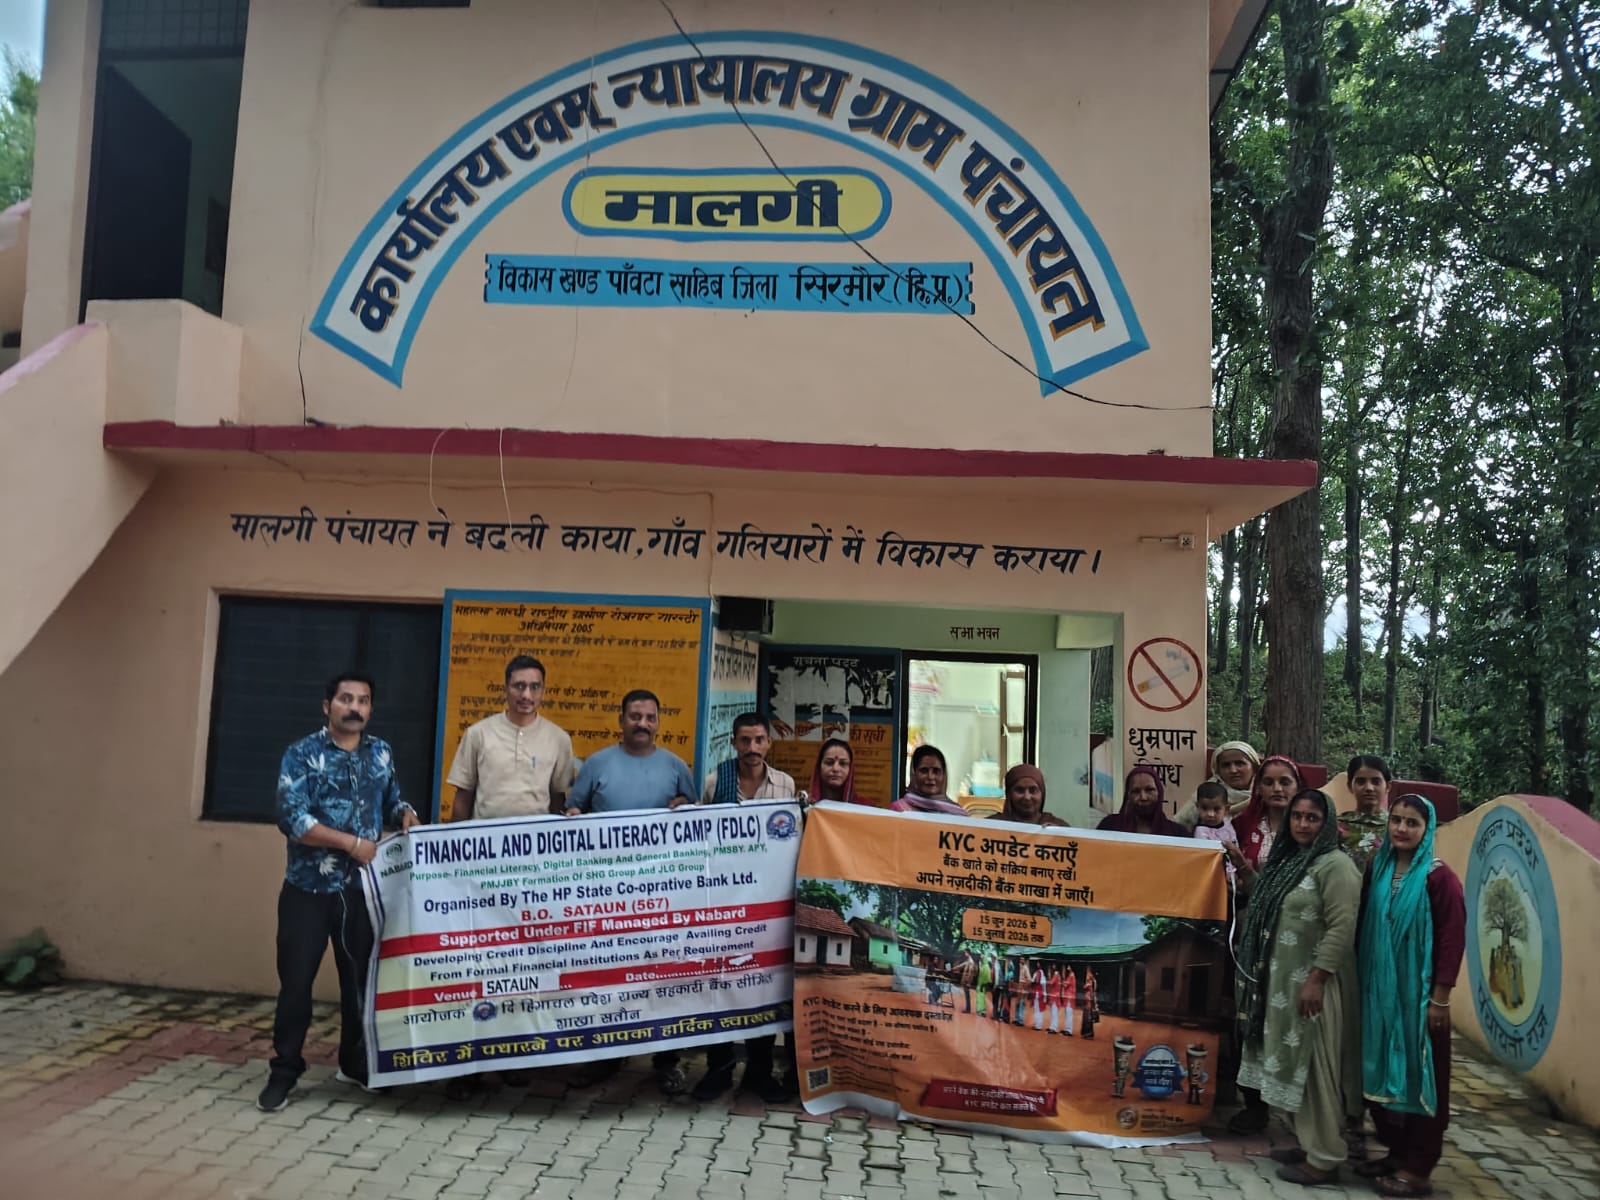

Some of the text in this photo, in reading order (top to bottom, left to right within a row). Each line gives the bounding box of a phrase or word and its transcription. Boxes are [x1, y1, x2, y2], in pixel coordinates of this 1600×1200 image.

[496, 82, 617, 161] एवम्
[608, 55, 850, 119] न्यायालय
[848, 78, 967, 172] ग्राम
[959, 141, 1106, 341] पंचायत
[605, 179, 843, 227] मालगी
[498, 261, 557, 292] विकास
[559, 268, 599, 294] खण्ड
[607, 263, 662, 296] पाँवटा
[669, 266, 723, 304] साहिब
[731, 266, 777, 301] जिला
[793, 266, 889, 307] सिरमौर
[230, 506, 318, 546] मालगी
[325, 509, 419, 548] पंचायत
[427, 508, 454, 548] ने
[465, 514, 550, 552] बदली
[560, 525, 642, 559] काया,
[648, 516, 706, 559] गाँव
[717, 523, 833, 564] गलियारों
[842, 525, 865, 564] में
[877, 531, 984, 568] विकास
[992, 545, 1087, 574] कराया
[571, 623, 594, 633] 2005
[950, 626, 1000, 641] सभा भवन
[415, 815, 761, 865] FINANCIAL AND DIGITAL LITERACY CAMP (FDLC)
[939, 831, 1078, 867] KYC अपडेट कराएँ
[454, 866, 498, 878] Financial
[500, 862, 541, 875] Literacy,
[543, 858, 573, 871] Digital
[576, 854, 613, 868] Banking
[615, 853, 633, 864] And
[636, 851, 671, 862] General
[480, 863, 705, 890] PMJJBY Formation Of SHG Group And JLG Group
[944, 853, 959, 867] बैंक
[962, 857, 982, 870] खाते
[985, 859, 997, 872] को
[1000, 862, 1027, 876] सक्रिय
[1031, 866, 1054, 880] बनाए
[424, 871, 757, 915] Organised By The HP State Co-oprative Bank Ltd.
[917, 870, 1094, 905] अपने नज़दीकी बैंक शाखा में जाएँ।
[439, 907, 746, 948] Supported Under FIF Managed By Nabard
[521, 897, 669, 922] B.O. SATAUN (567)
[980, 914, 1037, 930] 15 जून 2026 से
[414, 923, 767, 967] Developing Credit Discipline And Encourage Availing Credit
[972, 926, 1045, 943] 15 जुलाई 2026 तक
[430, 941, 755, 981] From Formal Financial Institutions As Per Requirement
[403, 1007, 466, 1026] आयोजक
[501, 998, 515, 1014] दि
[521, 995, 575, 1014] हिमाचल
[580, 991, 613, 1008] प्रदेश
[618, 988, 651, 1003] राज्य
[655, 981, 704, 998] सहकारी
[709, 977, 732, 992] बैंक
[434, 990, 478, 1003] Venue
[487, 976, 539, 995] SATAUN
[555, 1007, 642, 1030] शाखा सतौन
[392, 1050, 448, 1069] शिविर
[456, 1043, 475, 1061] में
[482, 1038, 549, 1056] पधारने
[555, 1035, 584, 1049] पर
[591, 1026, 654, 1045] आपका
[661, 1017, 714, 1038] हार्दिक
[720, 1009, 776, 1028] स्वागत
